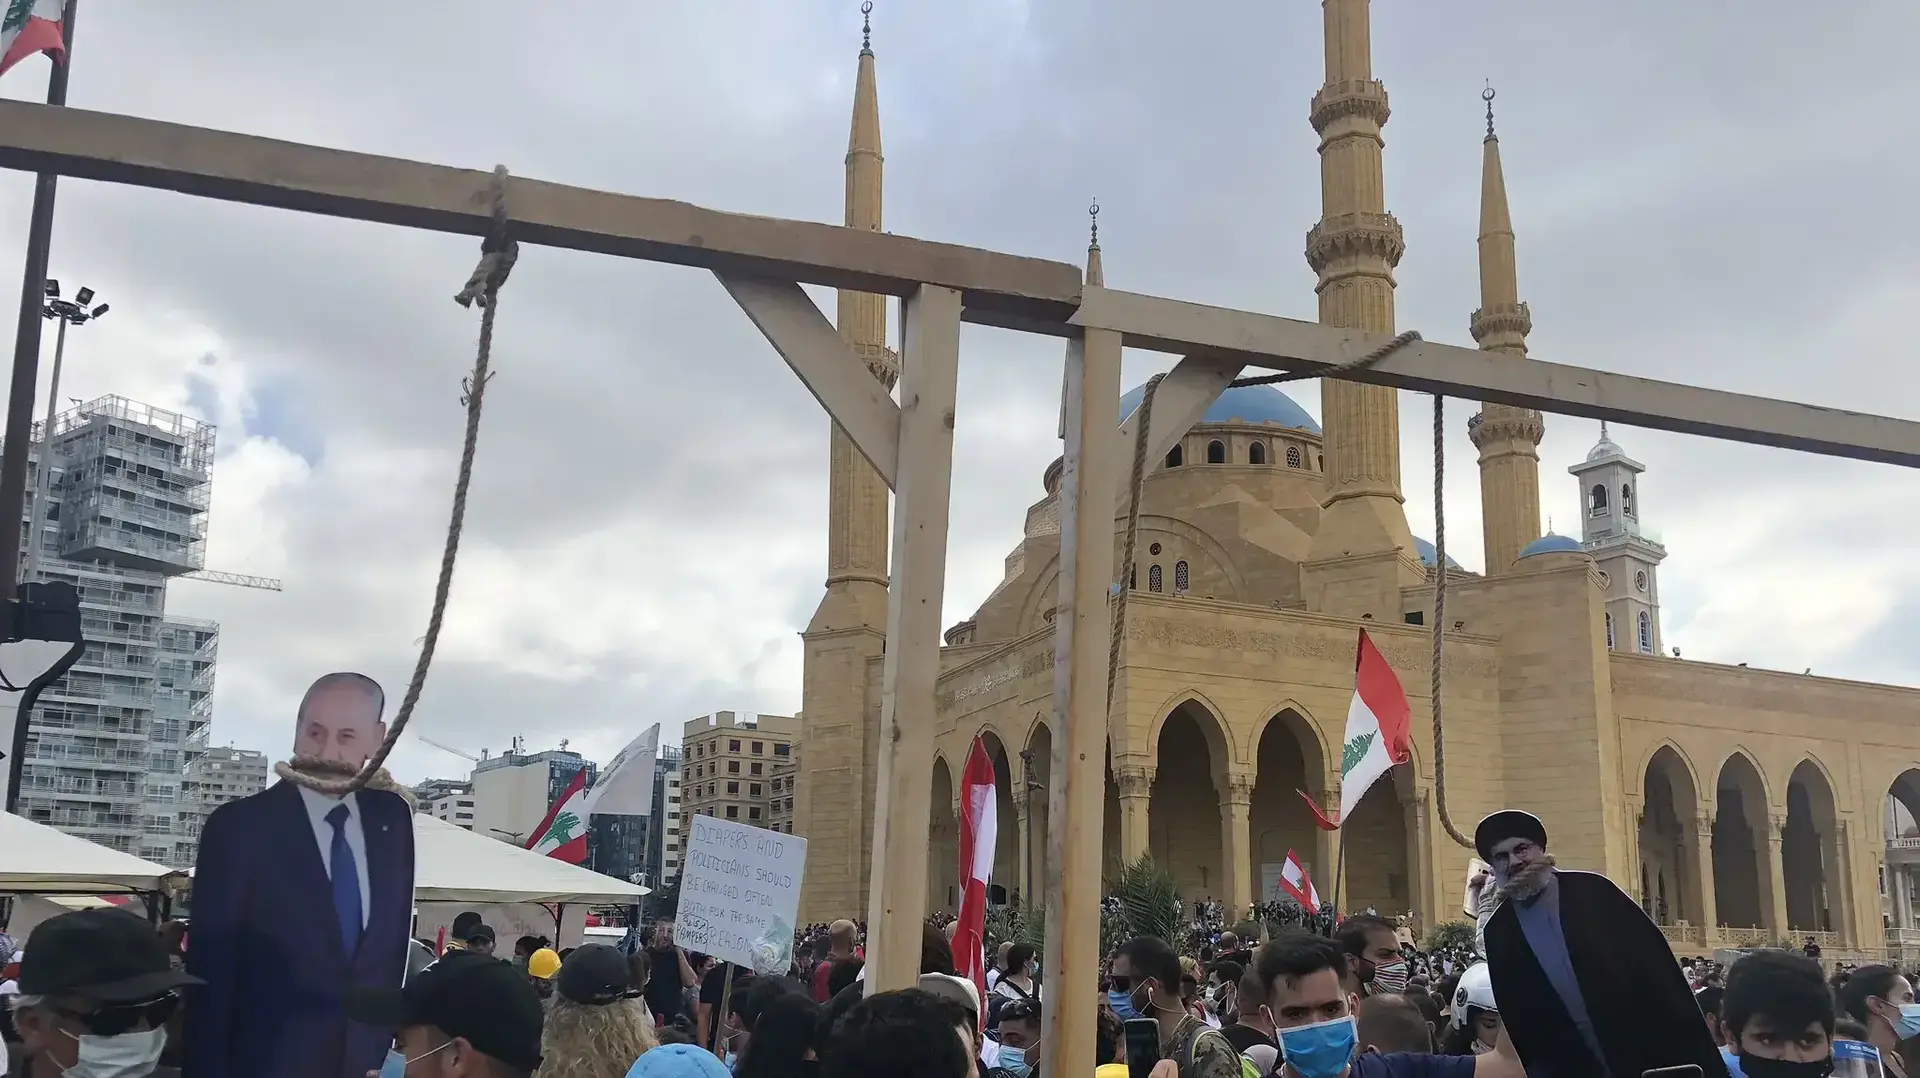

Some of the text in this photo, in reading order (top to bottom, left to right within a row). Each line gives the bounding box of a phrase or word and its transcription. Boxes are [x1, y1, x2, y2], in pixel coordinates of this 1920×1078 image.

[696, 823, 784, 859] DIAPERS AND
[689, 849, 791, 889] POLITICIANS SHOULD
[686, 873, 773, 907] BE CHANGED OFTEN
[683, 898, 766, 929] BOTH FOR THE SAME
[676, 923, 708, 946] PAMPERS
[1845, 1043, 1862, 1051] Face
